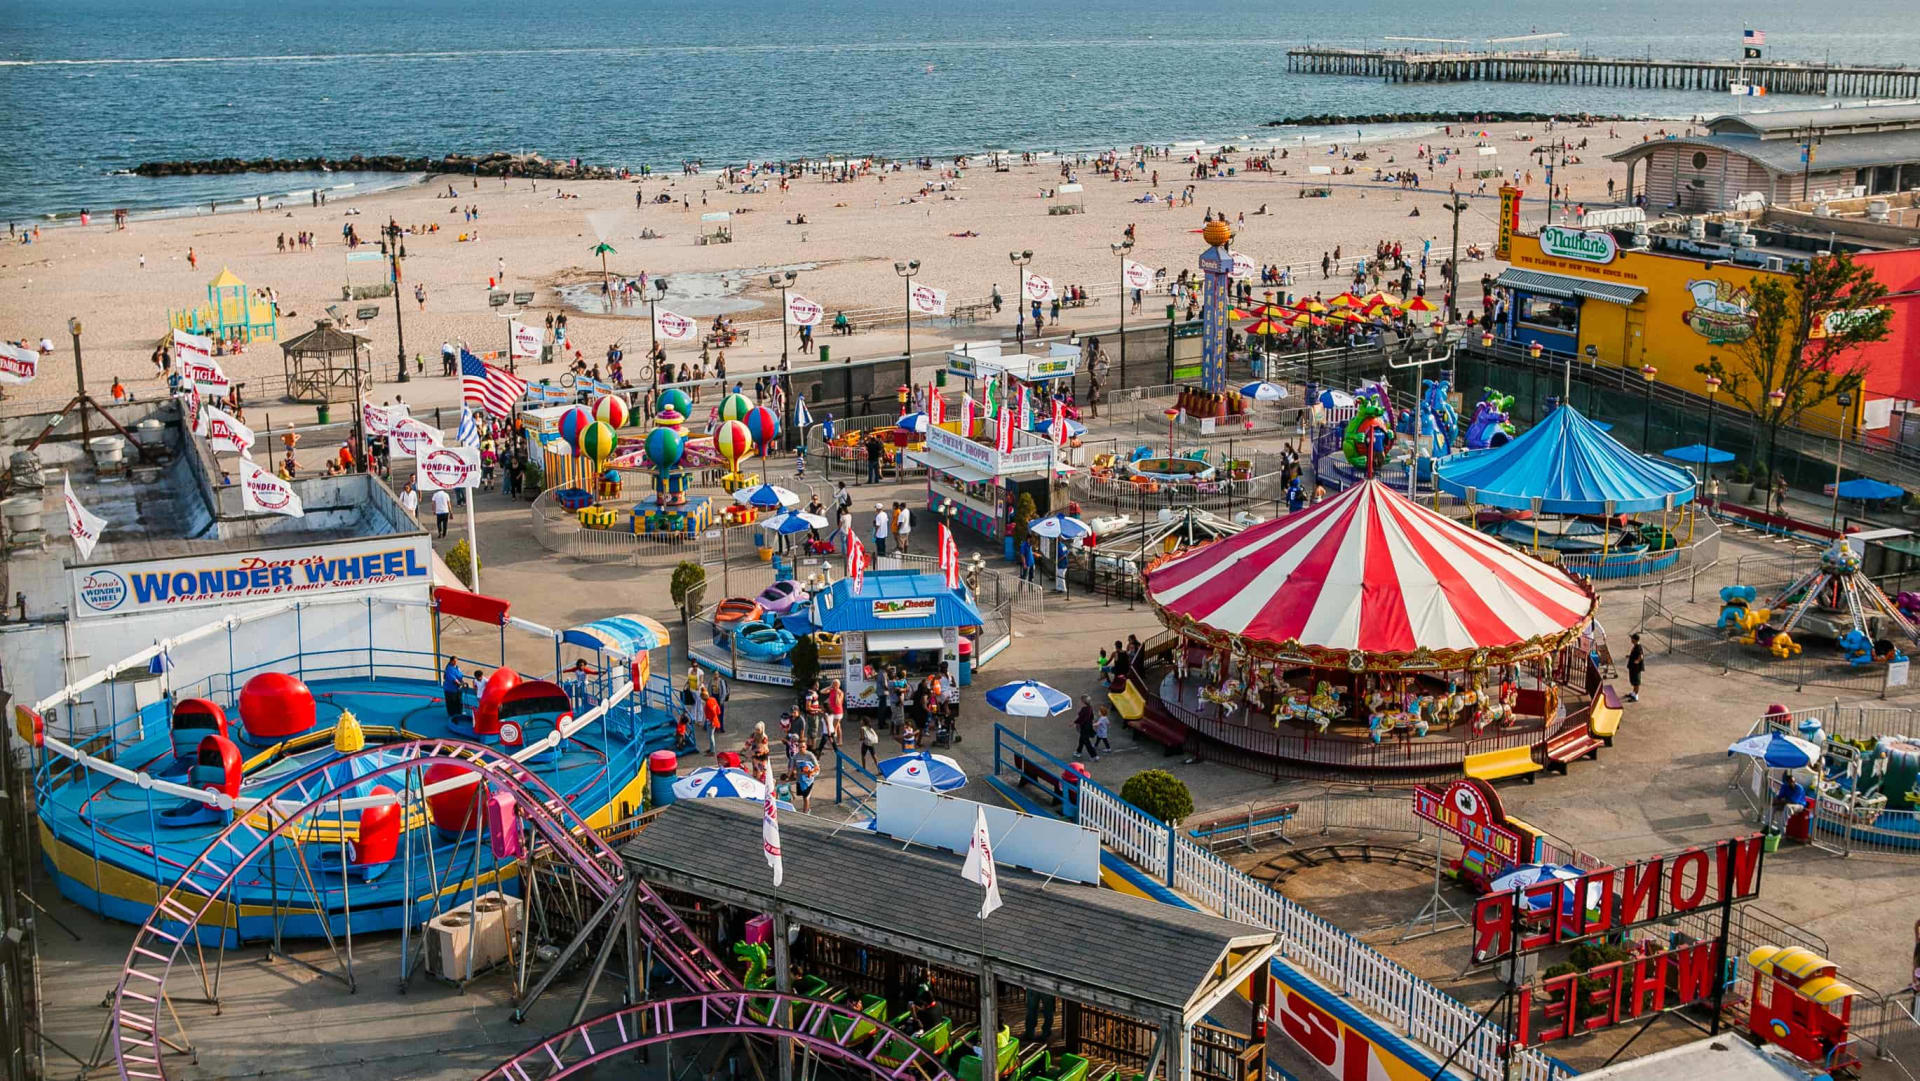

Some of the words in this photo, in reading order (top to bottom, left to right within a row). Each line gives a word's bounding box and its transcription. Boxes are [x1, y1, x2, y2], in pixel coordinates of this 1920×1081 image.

[1503, 194, 1511, 251] NATHANS
[1545, 228, 1608, 254] Nathan's
[1585, 265, 1601, 273] YORK
[1603, 269, 1622, 277] SINCE
[421, 462, 452, 472] WONDER
[247, 480, 277, 491] WONDER
[238, 555, 325, 571] Deno's
[129, 565, 293, 604] WONDER
[303, 548, 427, 584] WHEEL
[83, 577, 119, 589] Deno's
[167, 595, 176, 604] A
[180, 593, 215, 603] PLACE
[220, 590, 242, 599] FOR
[246, 587, 270, 596] FUN
[274, 585, 283, 593] &
[287, 581, 327, 592] FAMILY
[332, 578, 364, 588] SINCE
[368, 574, 396, 584] 1920
[86, 588, 121, 597] WONDER
[91, 595, 117, 603] WHEEL
[874, 601, 889, 611] Say
[903, 599, 935, 608] Cheese!
[748, 673, 767, 681] WILLIE
[1823, 799, 1842, 813] EXIT
[1420, 796, 1458, 829] TRAIN
[1460, 817, 1512, 858] STATION
